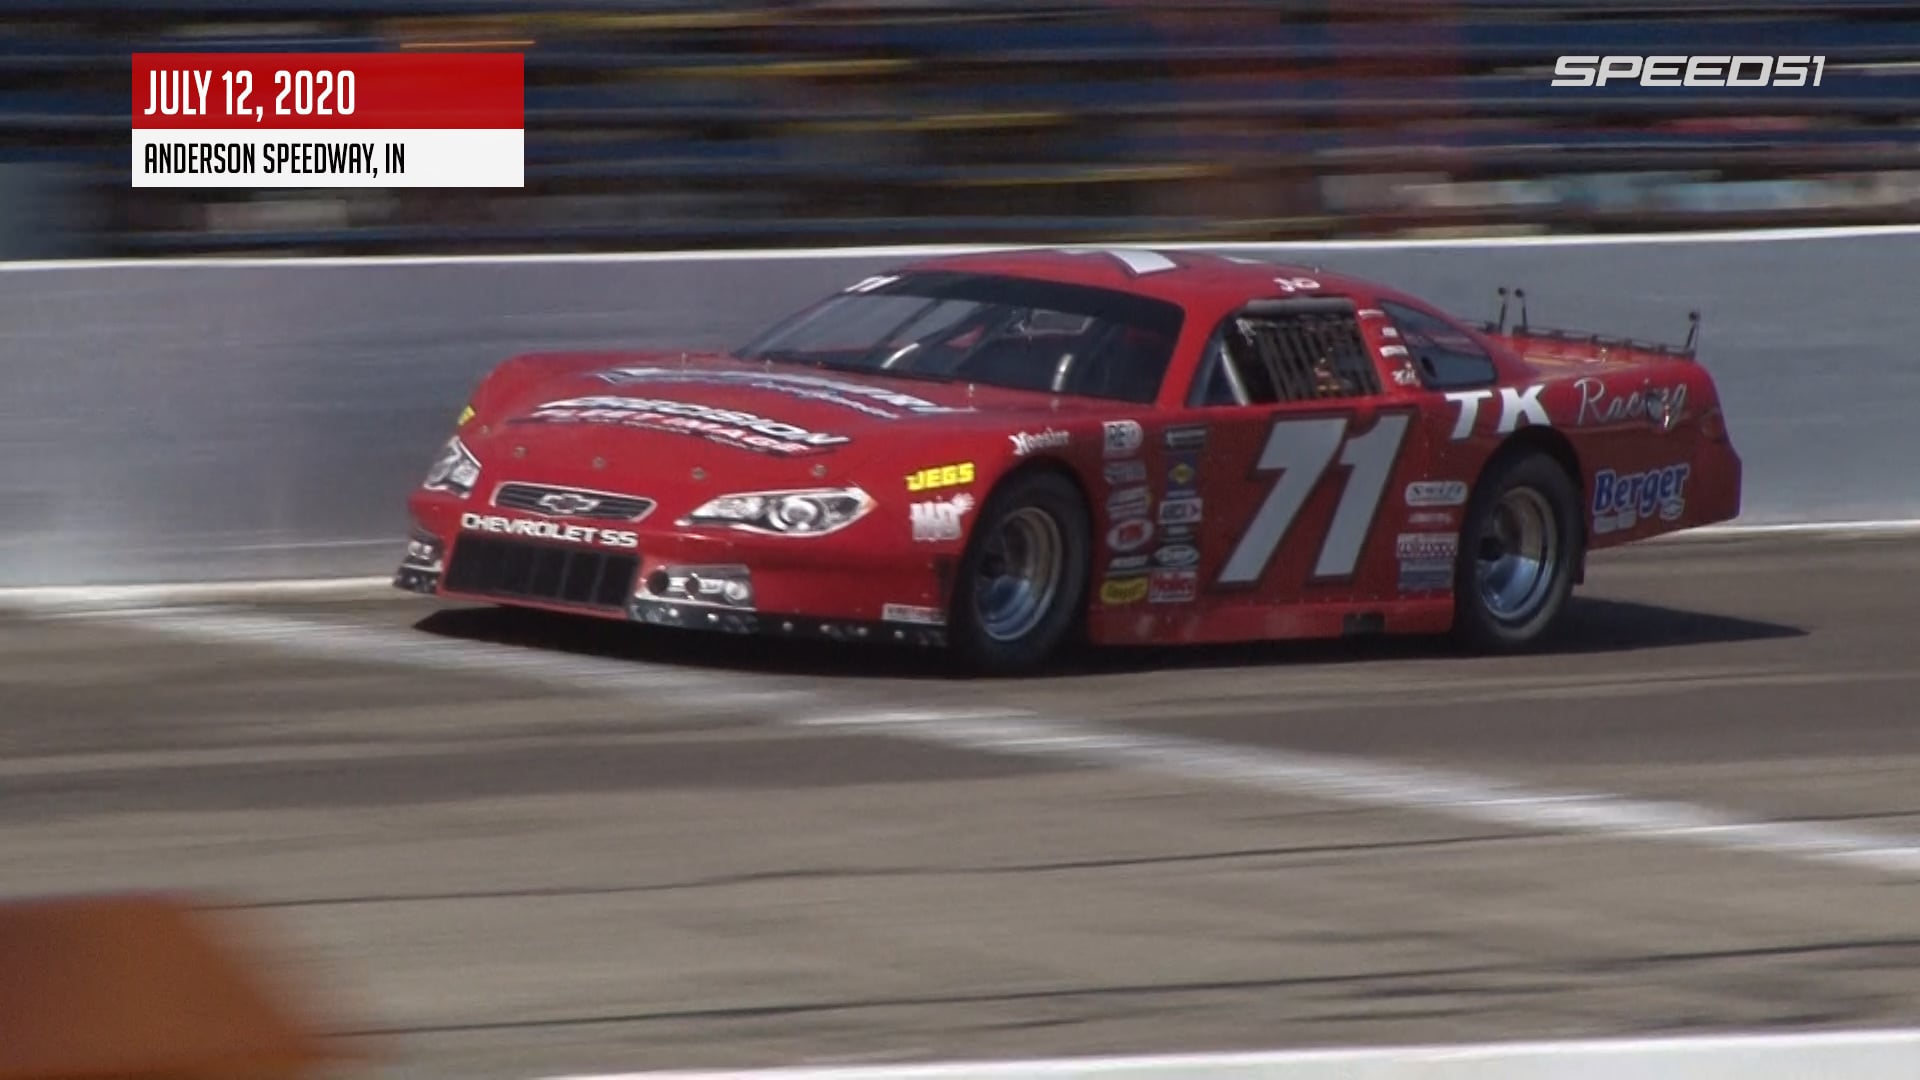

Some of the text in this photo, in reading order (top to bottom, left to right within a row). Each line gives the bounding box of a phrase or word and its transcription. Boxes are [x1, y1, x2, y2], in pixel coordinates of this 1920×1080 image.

[1445, 384, 1551, 440] TK
[905, 461, 975, 491] JEGS
[1218, 414, 1410, 582] 71
[1595, 463, 1689, 515] Berger
[461, 513, 638, 547] CHEVROLET SS
